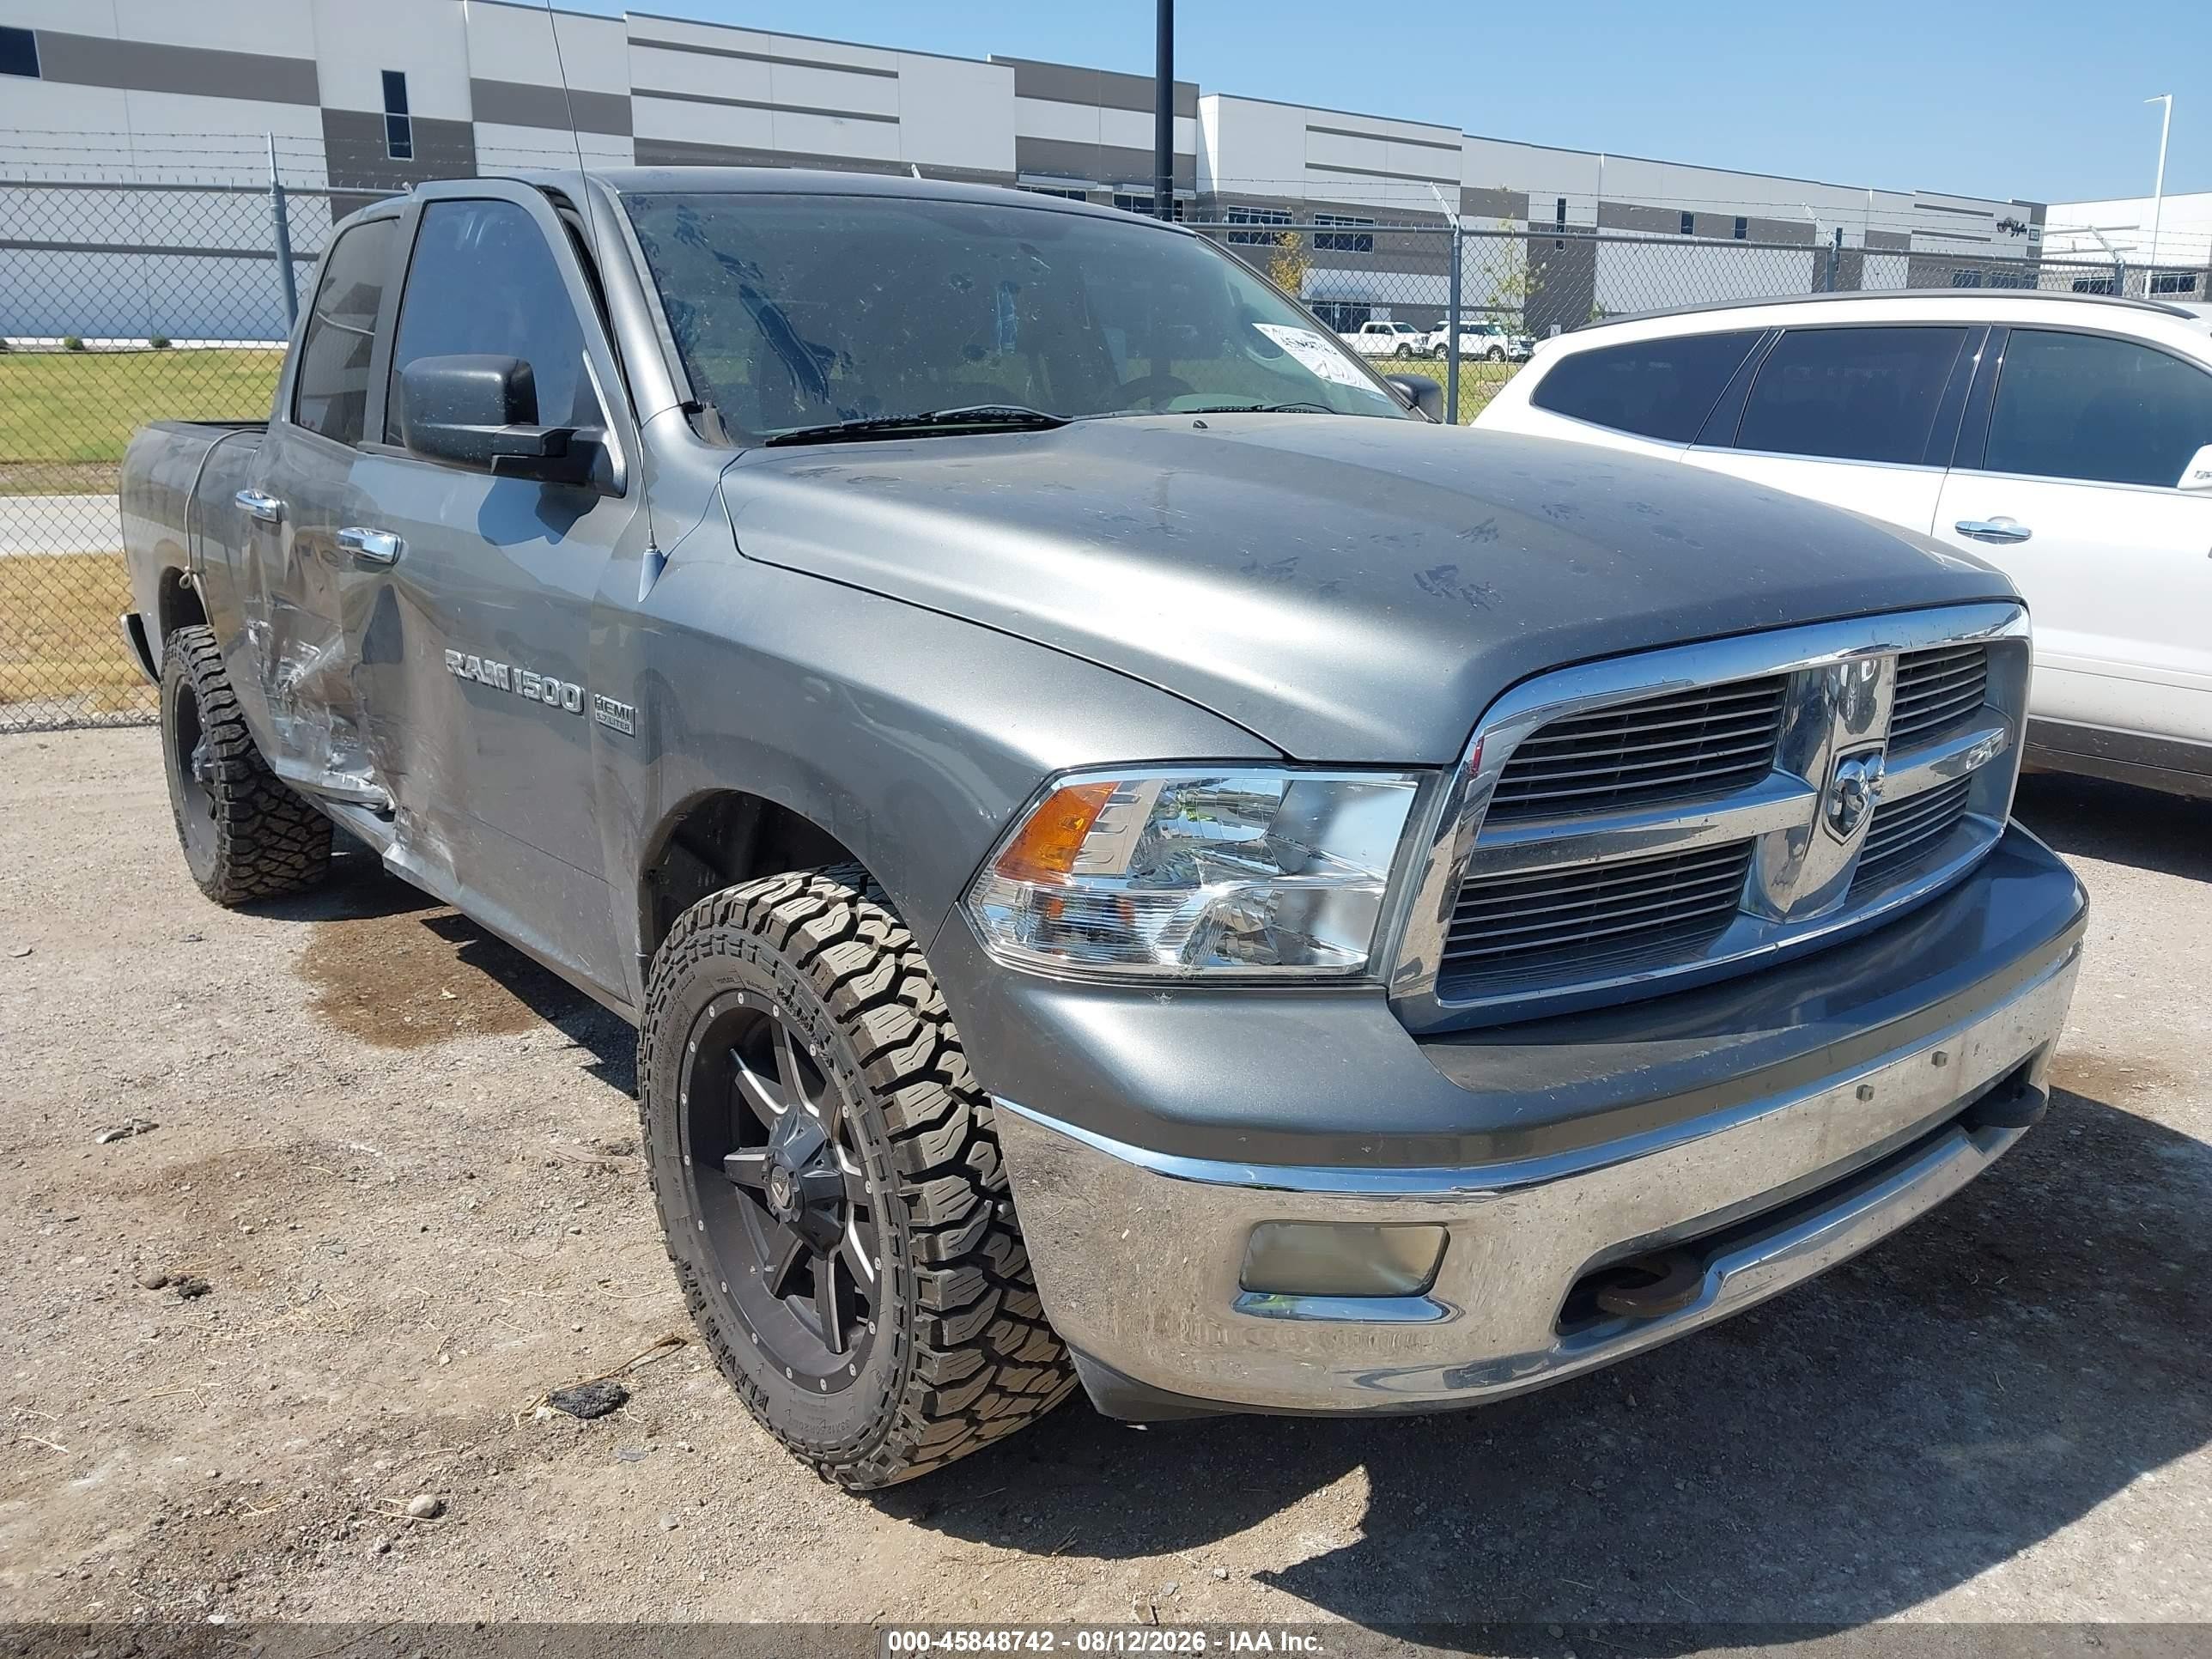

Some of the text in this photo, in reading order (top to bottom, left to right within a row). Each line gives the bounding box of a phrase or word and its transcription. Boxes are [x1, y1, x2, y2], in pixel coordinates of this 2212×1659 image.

[445, 648, 586, 716] RAM 1500
[594, 694, 631, 721] HEMI
[608, 714, 630, 732] LITER
